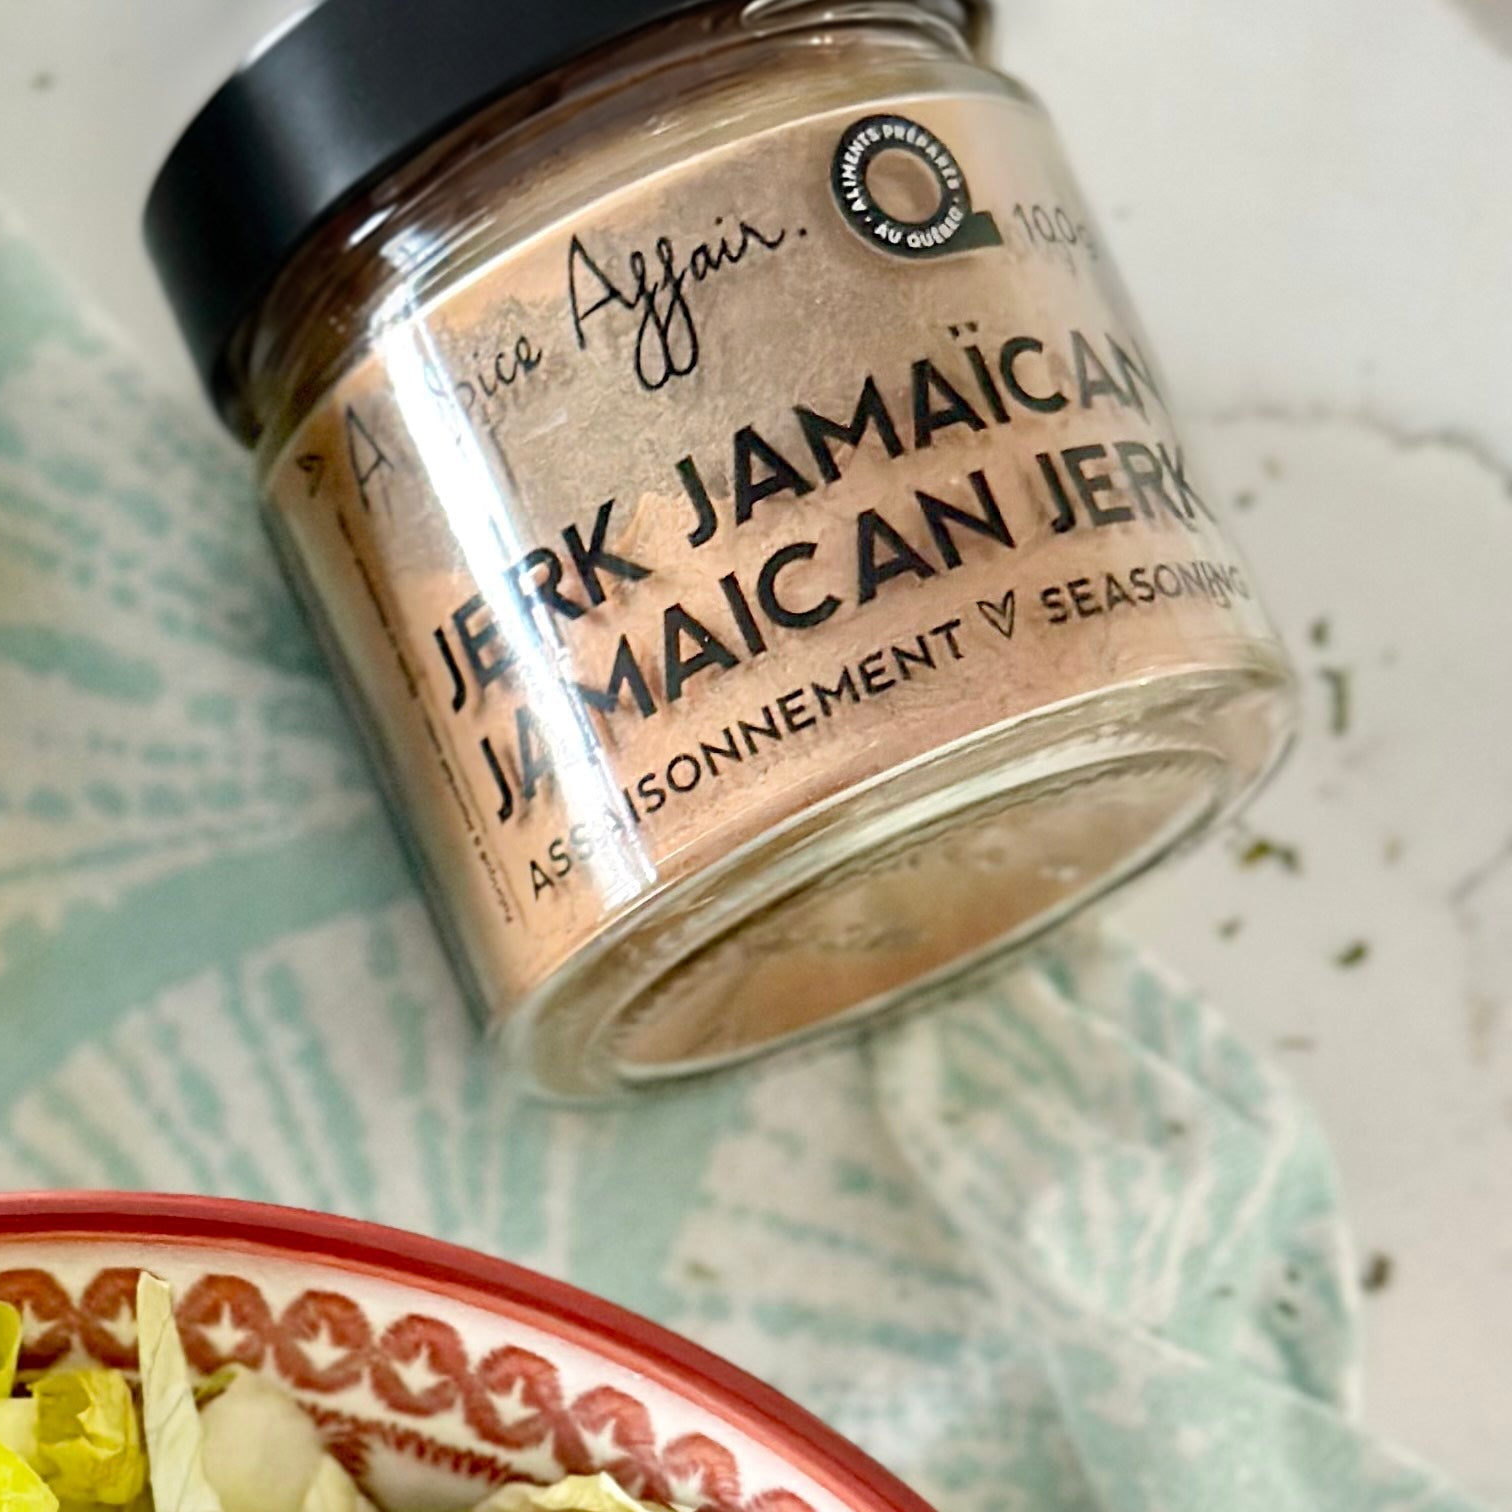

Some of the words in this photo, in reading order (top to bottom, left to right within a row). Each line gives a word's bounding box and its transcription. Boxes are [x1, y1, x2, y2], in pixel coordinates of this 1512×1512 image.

[841, 125, 881, 213] ALIMENTS
[873, 220, 903, 245] AU
[906, 204, 965, 249] QUÉBEC
[432, 498, 653, 714] JERK
[675, 321, 1170, 548] JAMAÏCAN
[480, 470, 1016, 823] JAMAICAN
[1034, 439, 1219, 534] JERK
[1039, 559, 1251, 625] SEASONING
